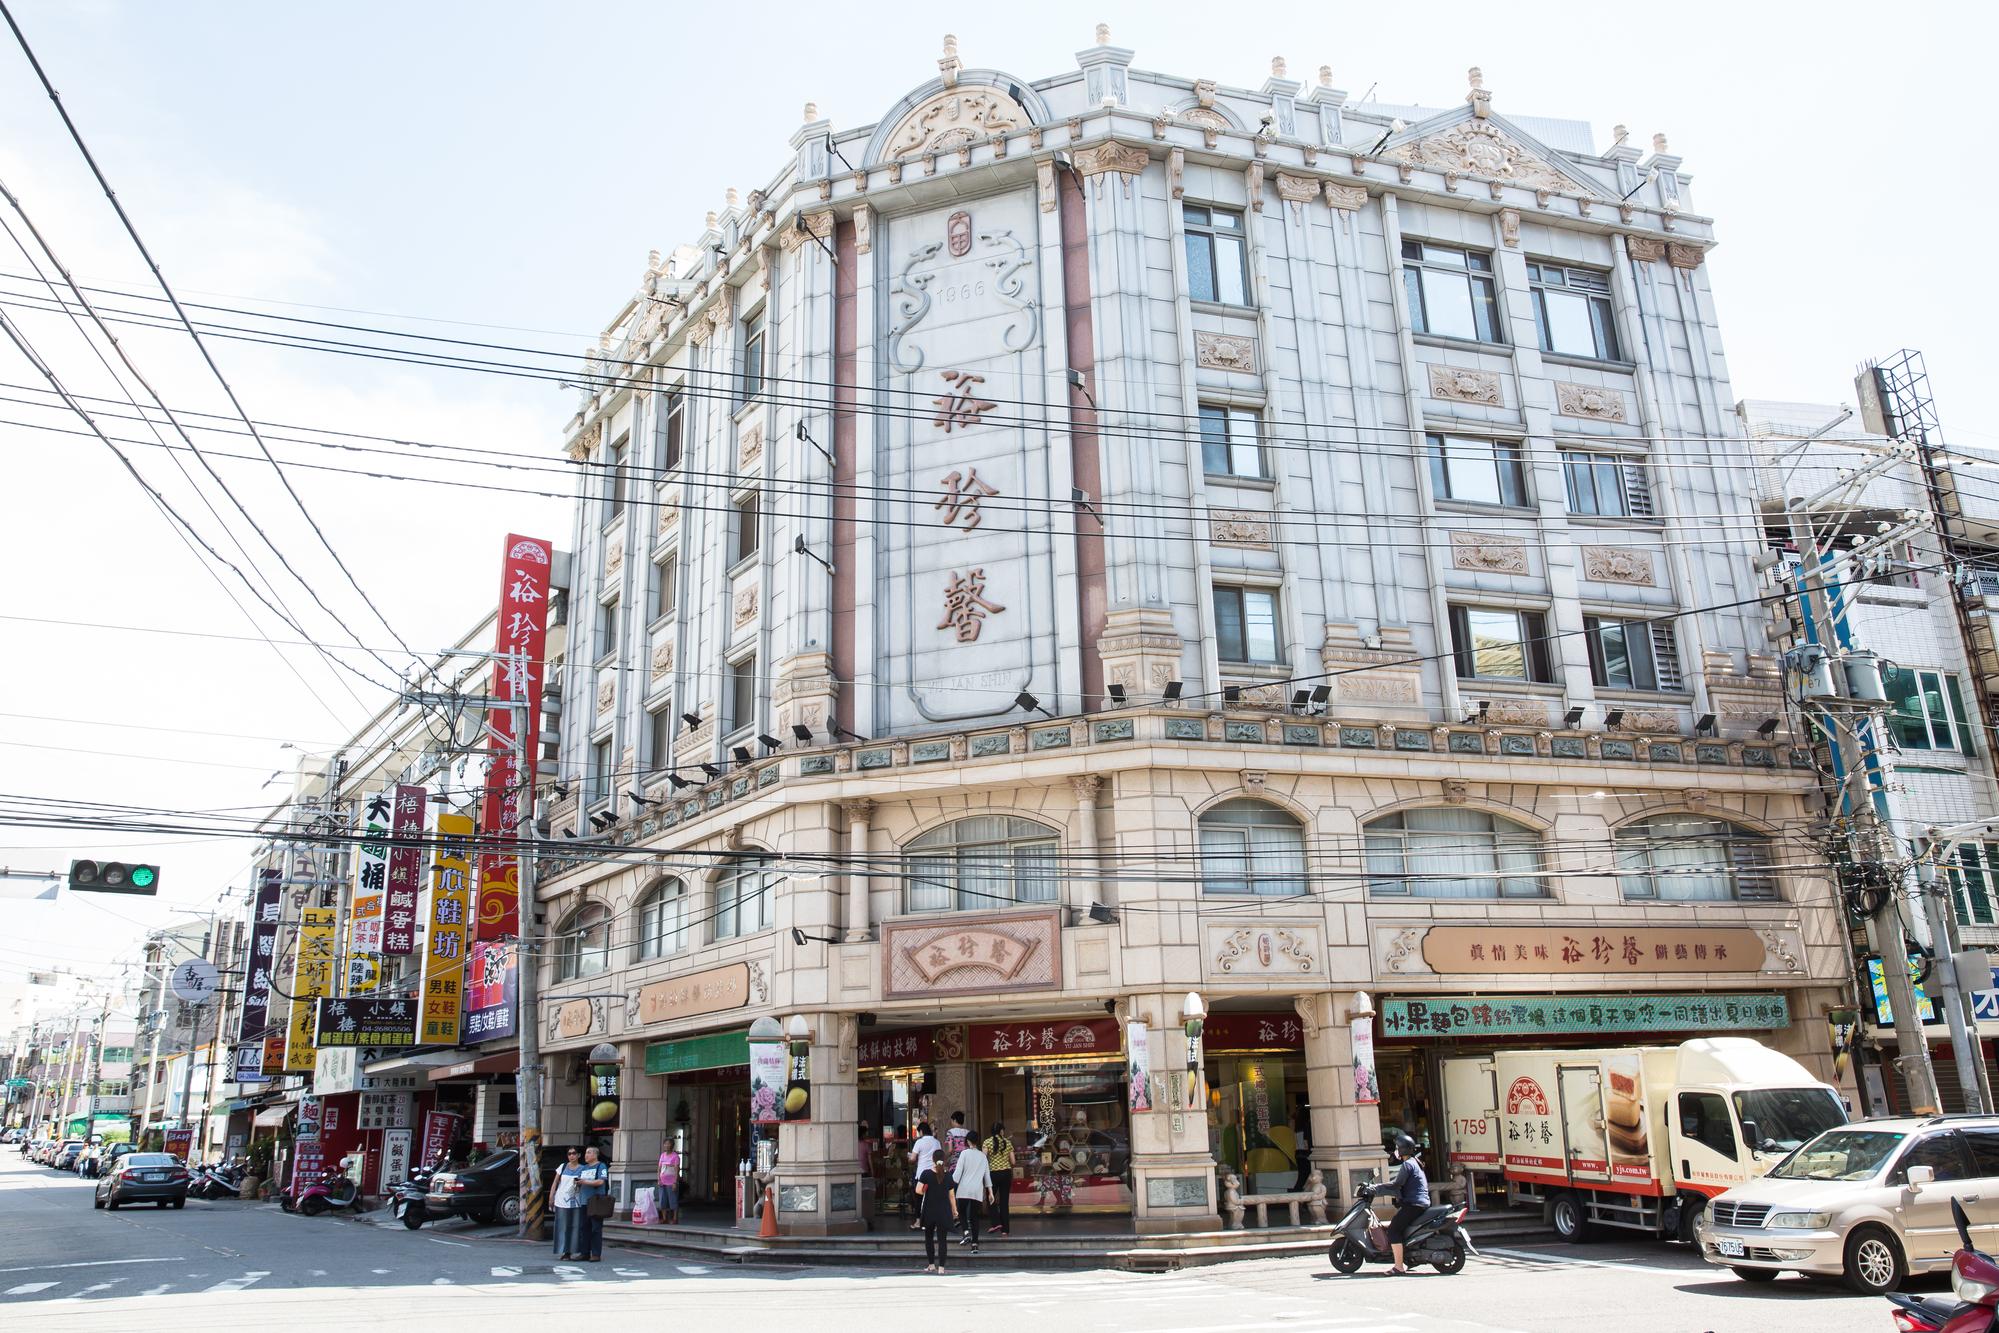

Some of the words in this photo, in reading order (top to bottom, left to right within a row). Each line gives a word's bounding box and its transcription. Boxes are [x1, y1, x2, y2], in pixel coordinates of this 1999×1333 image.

[932, 371, 1006, 643] 裕珍馨
[927, 935, 1012, 968] 裕珍馨
[1561, 936, 1644, 965] 裕珍馨
[992, 1027, 1059, 1052] 裕珍馨
[1453, 1119, 1487, 1135] 1759
[1509, 1121, 1553, 1145] 裕珍馨
